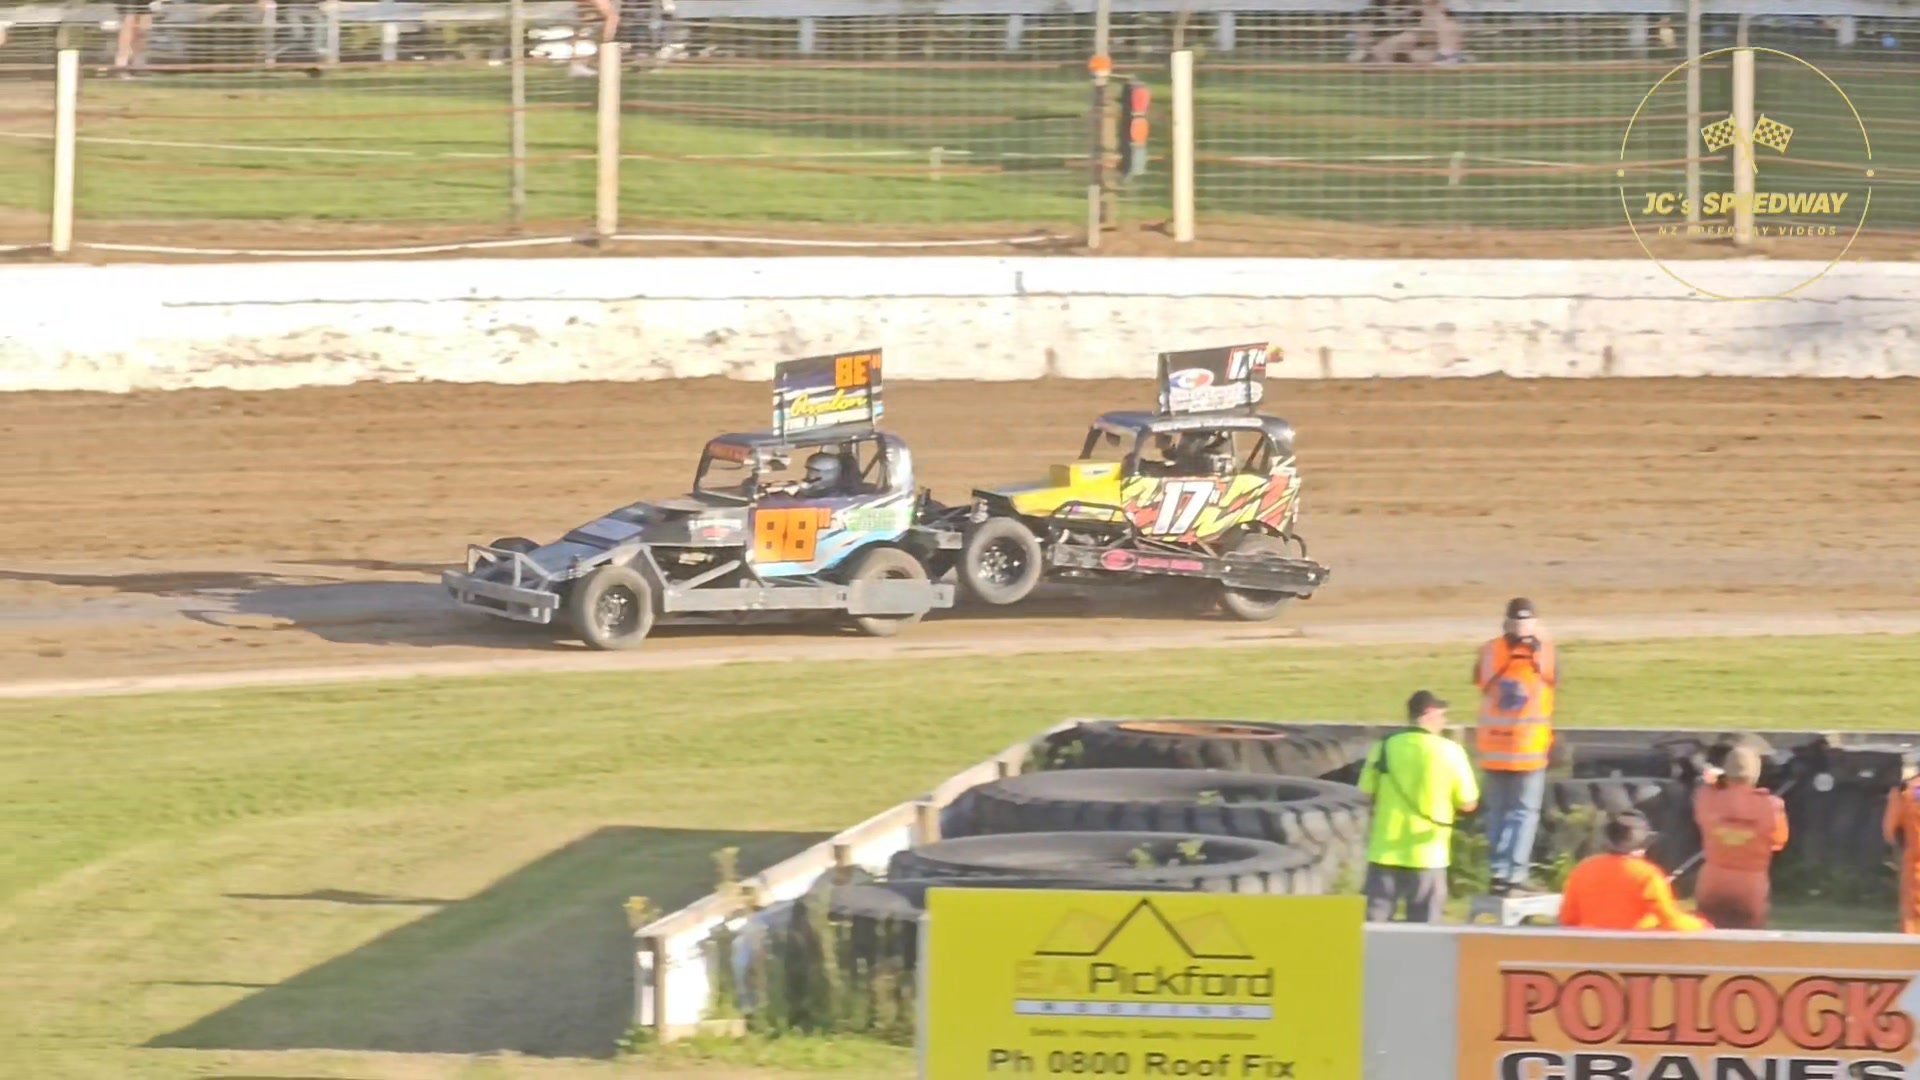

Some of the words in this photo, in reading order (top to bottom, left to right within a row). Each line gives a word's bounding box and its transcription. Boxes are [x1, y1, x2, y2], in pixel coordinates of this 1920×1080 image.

[1089, 963, 1275, 997] Pickford
[1496, 970, 1914, 1052] POLLOCK
[988, 1048, 1035, 1073] Ph
[1048, 1050, 1130, 1075] 0800
[1144, 1052, 1231, 1077] Roof
[1243, 1054, 1296, 1078] Fix
